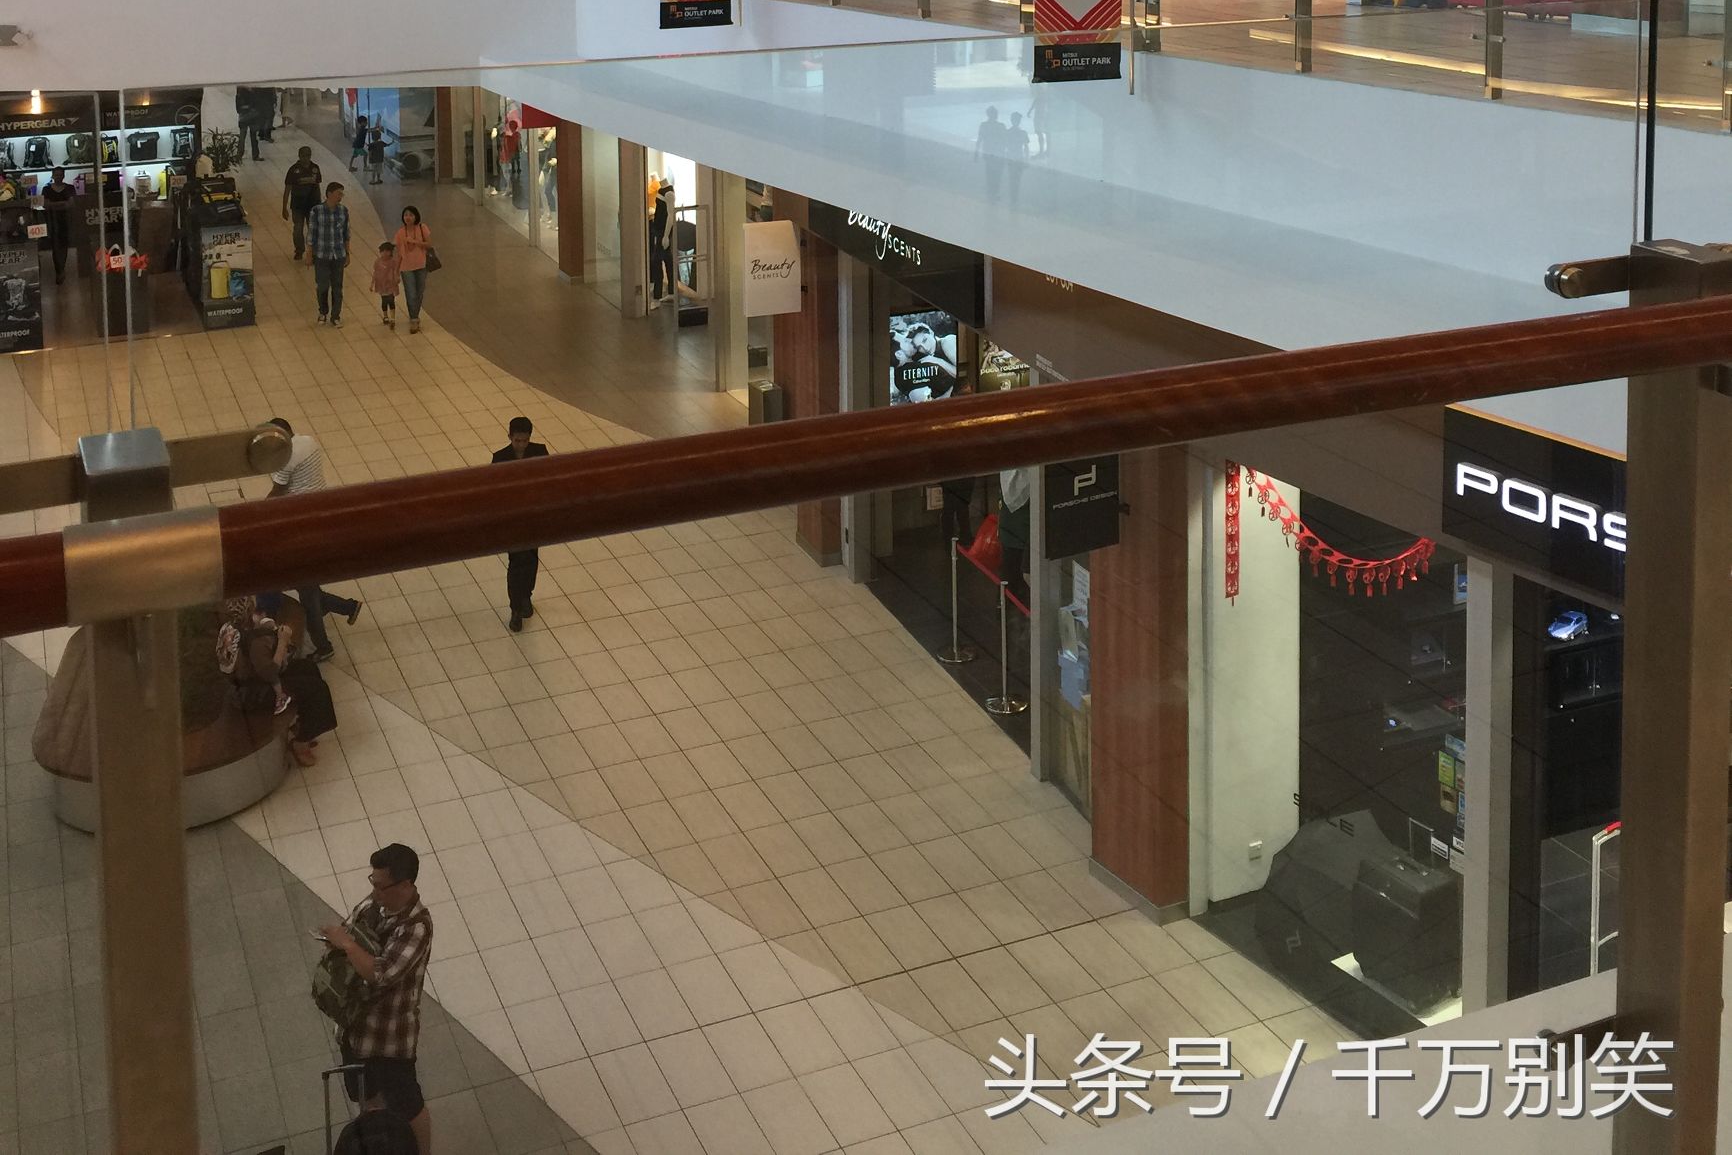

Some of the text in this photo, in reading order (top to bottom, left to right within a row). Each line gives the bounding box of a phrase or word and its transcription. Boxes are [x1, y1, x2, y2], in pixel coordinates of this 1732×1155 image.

[708, 8, 724, 16] PARK
[1062, 56, 1112, 67] OUTLET PARK
[887, 235, 921, 265] SCENTS
[751, 258, 796, 279] Beauty
[752, 272, 780, 280] SCENTS
[903, 365, 939, 380] ETERNITY
[1053, 497, 1089, 511] PORSCHE
